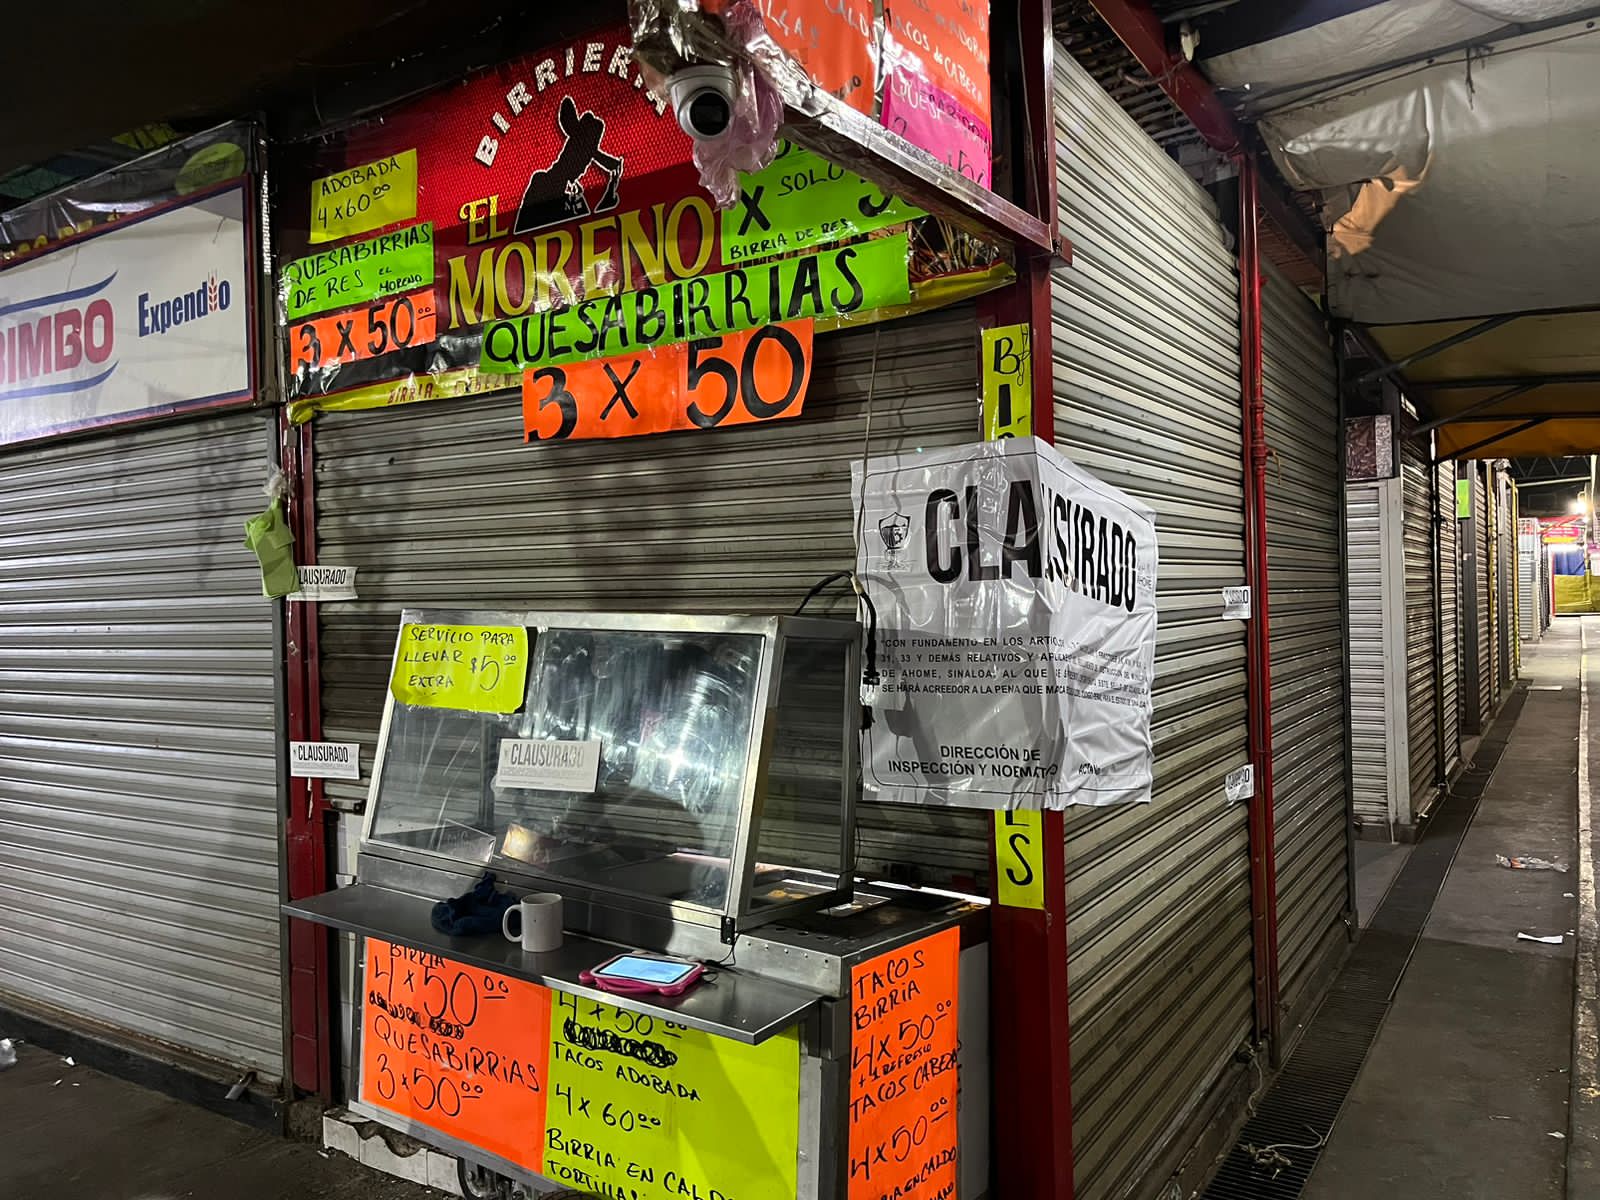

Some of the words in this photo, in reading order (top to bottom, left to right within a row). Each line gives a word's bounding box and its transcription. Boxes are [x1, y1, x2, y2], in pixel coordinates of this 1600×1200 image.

[322, 157, 400, 196] ADOBADA
[459, 194, 510, 245] EL
[730, 232, 788, 260] BIRRIA
[796, 227, 815, 242] DE
[821, 217, 850, 235] RES
[284, 223, 432, 285] QUESABIRRIAS
[447, 195, 715, 330] MORENO
[294, 286, 317, 309] DE
[324, 269, 365, 298] RES
[379, 274, 423, 292] MORENO
[485, 248, 865, 367] QUESABIRRIAS
[299, 324, 322, 372] 3
[528, 366, 579, 441] 3
[686, 325, 806, 429] 50
[298, 568, 347, 585] LAUSURADO
[408, 627, 474, 644] SERVICIO
[983, 637, 997, 647] EN
[1002, 636, 1024, 646] LOS
[404, 649, 464, 664] LLEVAR
[881, 669, 896, 678] DE
[1003, 669, 1017, 678] AL
[1024, 668, 1048, 678] QUE
[916, 654, 923, 663] Y
[928, 652, 961, 663] DEMÁS
[967, 653, 1021, 663] RELATIVOS
[1026, 652, 1034, 662] Y
[408, 675, 455, 688] EXTRA
[882, 684, 895, 693] SE
[896, 682, 920, 693] HARÁ
[922, 684, 970, 694] ACREEDOR
[971, 685, 978, 694] A
[980, 685, 993, 694] LA
[994, 684, 1021, 694] PENA
[1022, 685, 1043, 694] QUE
[298, 745, 349, 763] CLAUSURADO
[888, 760, 975, 775] INSPECCIÓN
[977, 764, 987, 776] Y
[940, 744, 1020, 761] DIRECCIÓN
[1022, 749, 1041, 762] DE
[390, 943, 446, 969] BIRRIA
[854, 950, 925, 1000] TACOS
[374, 955, 394, 1002] 4
[854, 980, 921, 1030] BIRRIA
[374, 1014, 540, 1092] QUESABIRRIAS
[553, 1041, 604, 1071] TACOS
[616, 1065, 702, 1101] ADOBADA
[852, 1034, 875, 1077] 4
[377, 1053, 395, 1100] 3
[556, 1083, 572, 1116] 4
[849, 1074, 908, 1123] TACOS
[546, 1127, 616, 1168] BIRRIA
[626, 1163, 655, 1183] EN
[851, 1146, 870, 1180] 4
